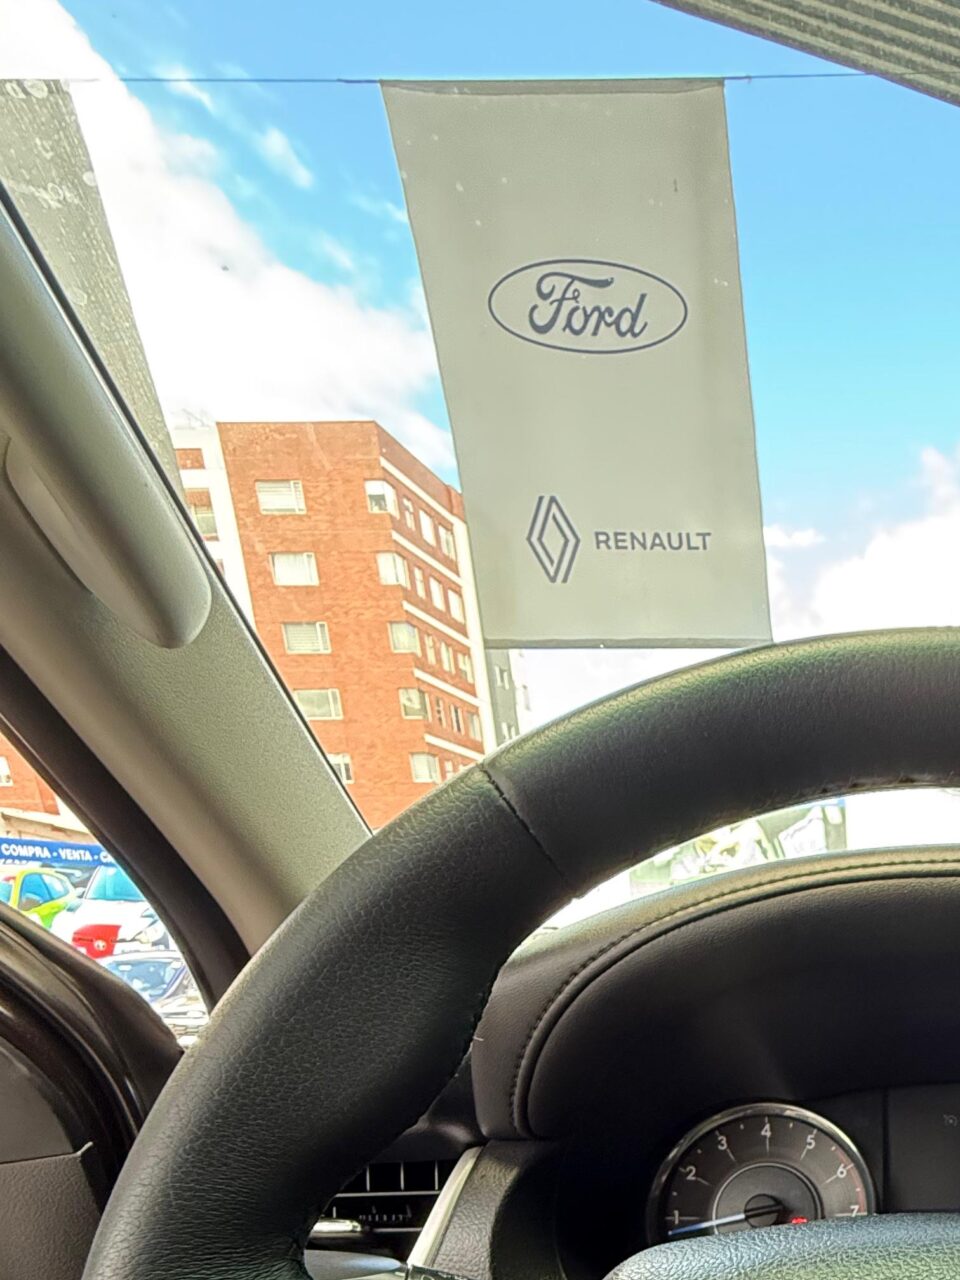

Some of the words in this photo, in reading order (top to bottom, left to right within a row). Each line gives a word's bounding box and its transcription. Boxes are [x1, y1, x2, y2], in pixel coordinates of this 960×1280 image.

[528, 271, 648, 338] Ford
[594, 531, 712, 551] RENAULT
[1, 843, 51, 859] COMPRA
[58, 847, 92, 861] VENTA
[761, 1123, 771, 1138] 4
[718, 1135, 728, 1150] 3
[806, 1134, 815, 1149] 5
[686, 1166, 697, 1180] 2
[837, 1164, 847, 1178] 6
[850, 1205, 859, 1217] 7
